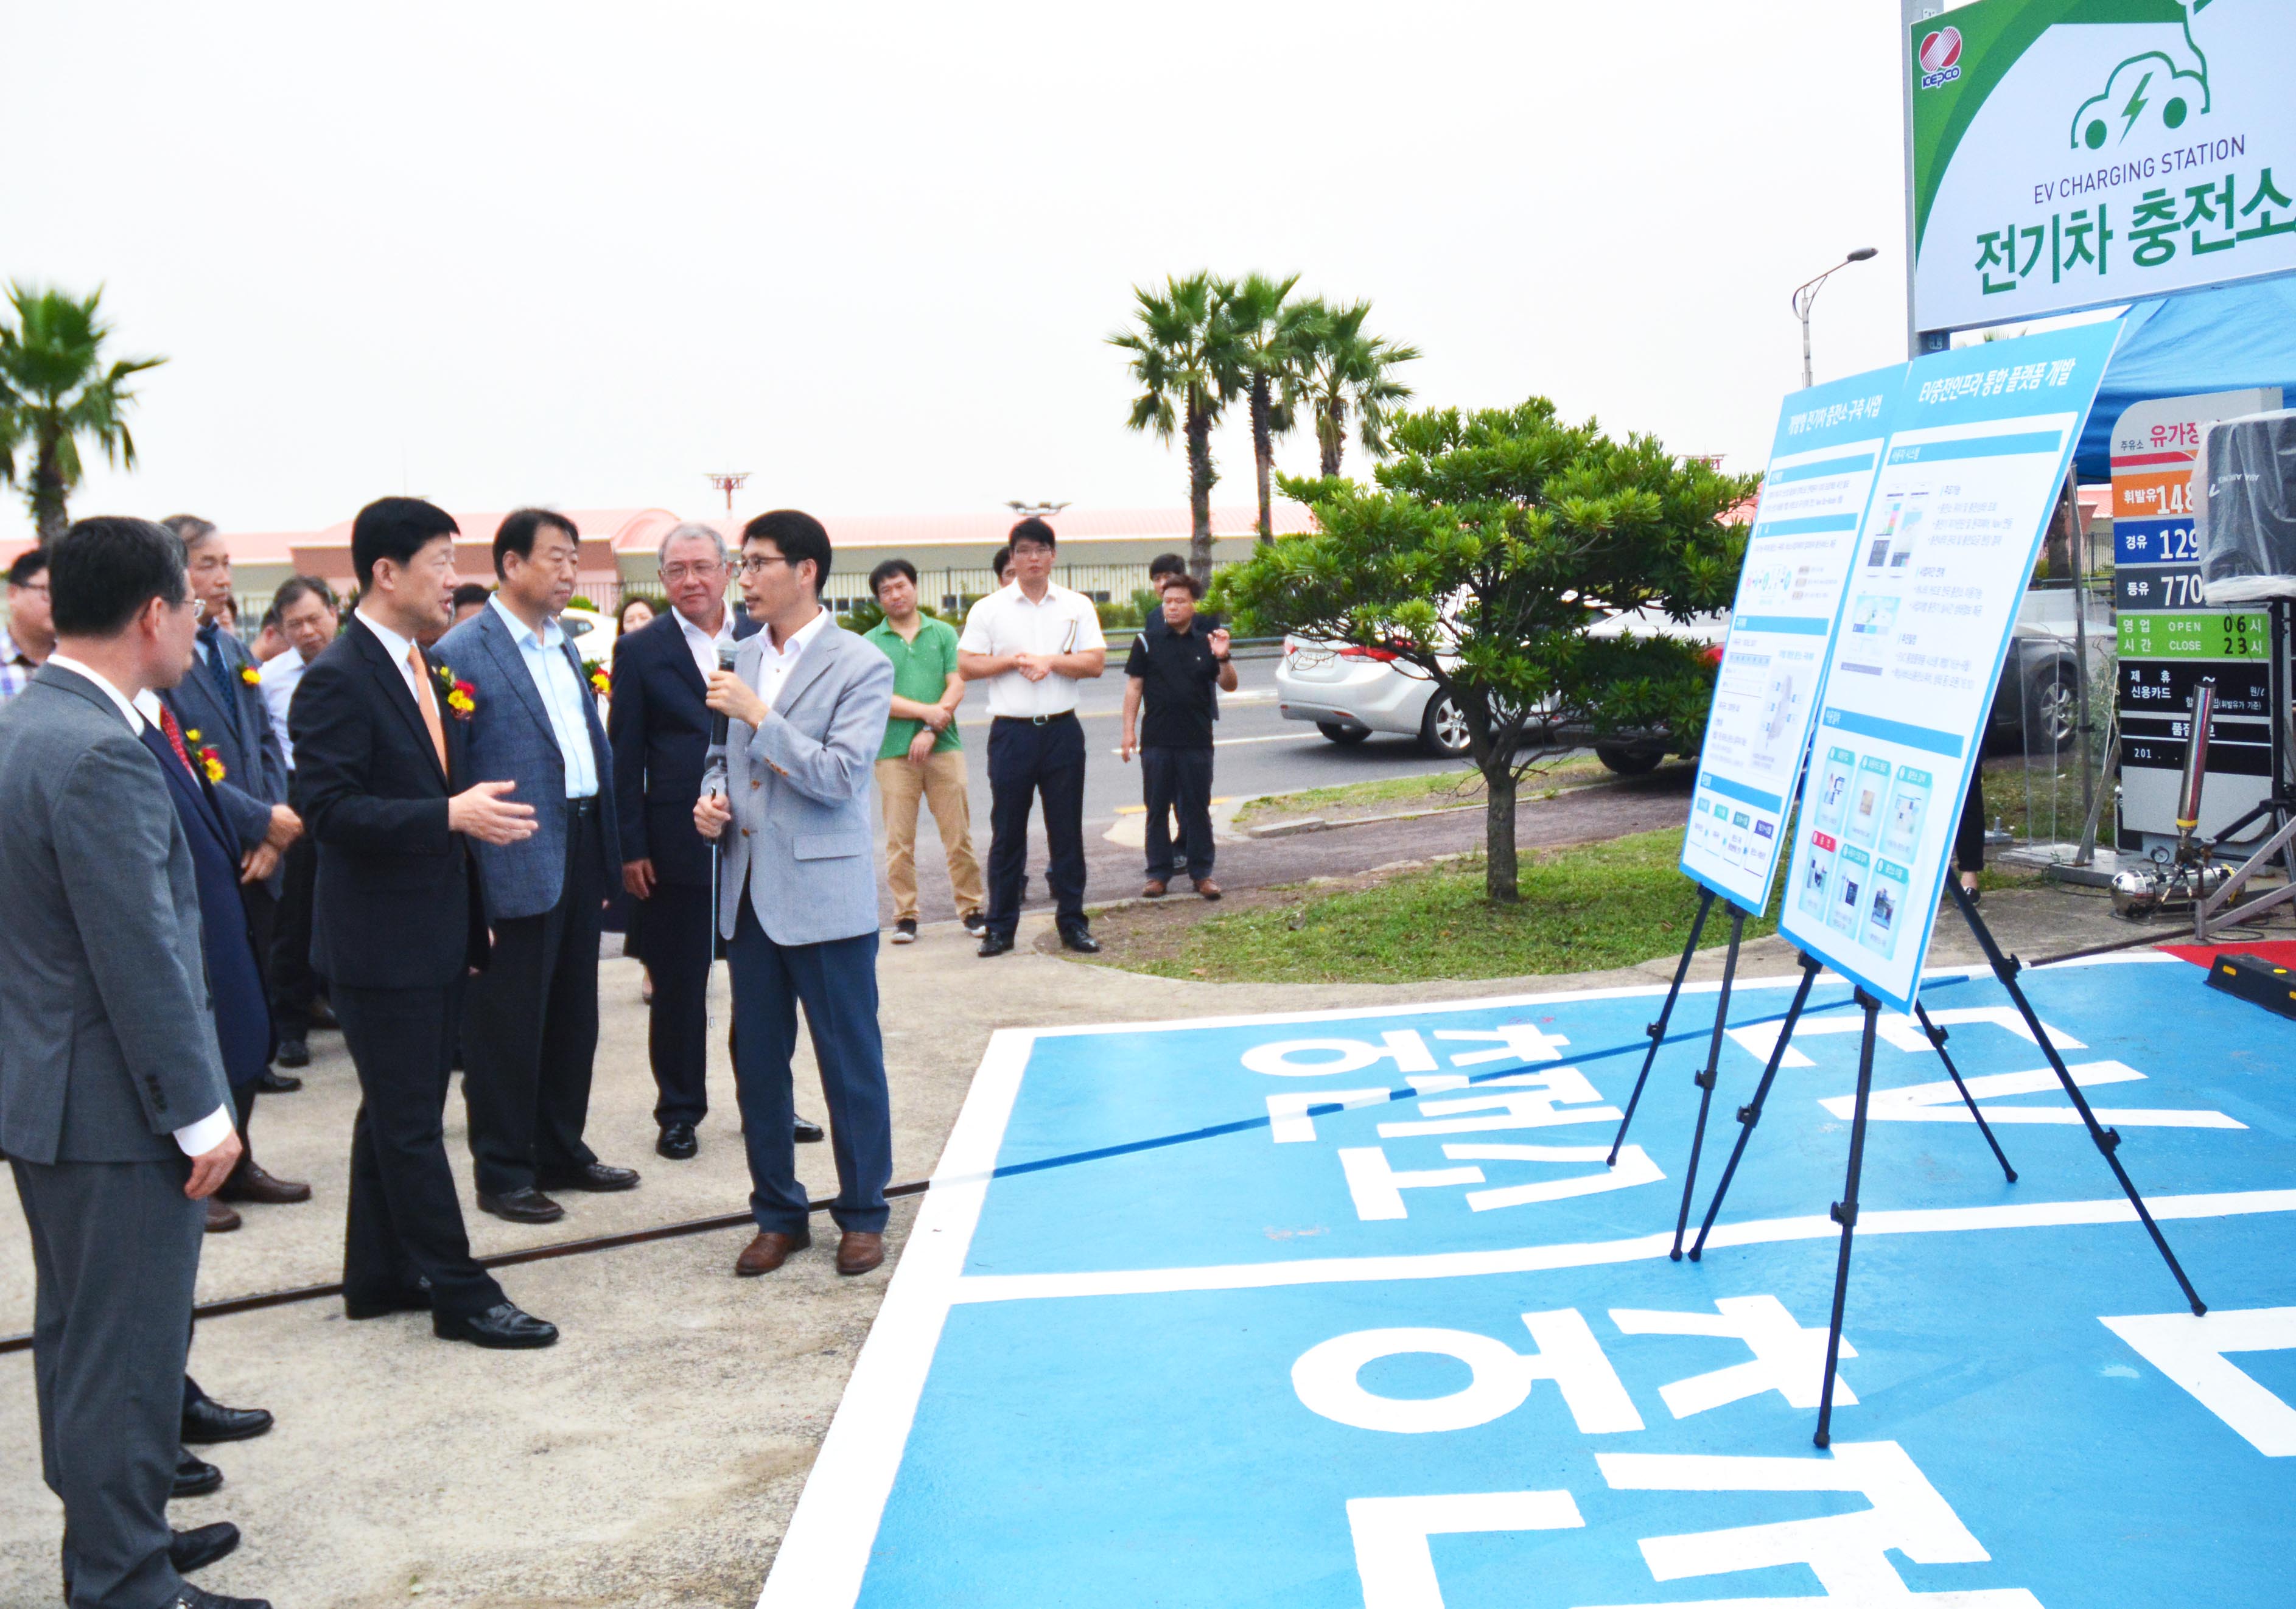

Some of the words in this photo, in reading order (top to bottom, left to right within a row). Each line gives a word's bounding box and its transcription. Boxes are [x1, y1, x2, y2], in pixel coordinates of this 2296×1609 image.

[1922, 67, 1960, 88] KEPCO
[2034, 181, 2054, 204] EV
[2060, 157, 2154, 198] CHARGING
[2161, 134, 2244, 174] STATION
[1975, 203, 2113, 295] 전기차
[2127, 167, 2296, 268] 충전소
[1918, 372, 1984, 405] EV충전인프라
[1982, 368, 2009, 397] 통합
[2006, 361, 2047, 393] 플랫폼
[2045, 357, 2076, 386] 개발
[1864, 394, 1883, 418] 사업
[2121, 439, 2144, 452] 주유소
[2124, 487, 2157, 504] 휘발유
[2126, 534, 2147, 550] 경유
[2127, 582, 2149, 596] 등유
[2161, 574, 2203, 606] 770
[2168, 621, 2202, 632] OPEN
[2223, 615, 2247, 633] 06
[2169, 640, 2202, 651] CLOSE
[2224, 637, 2248, 655] 23
[2131, 686, 2172, 699] 신용카드
[1240, 1024, 1667, 1221] 충전소
